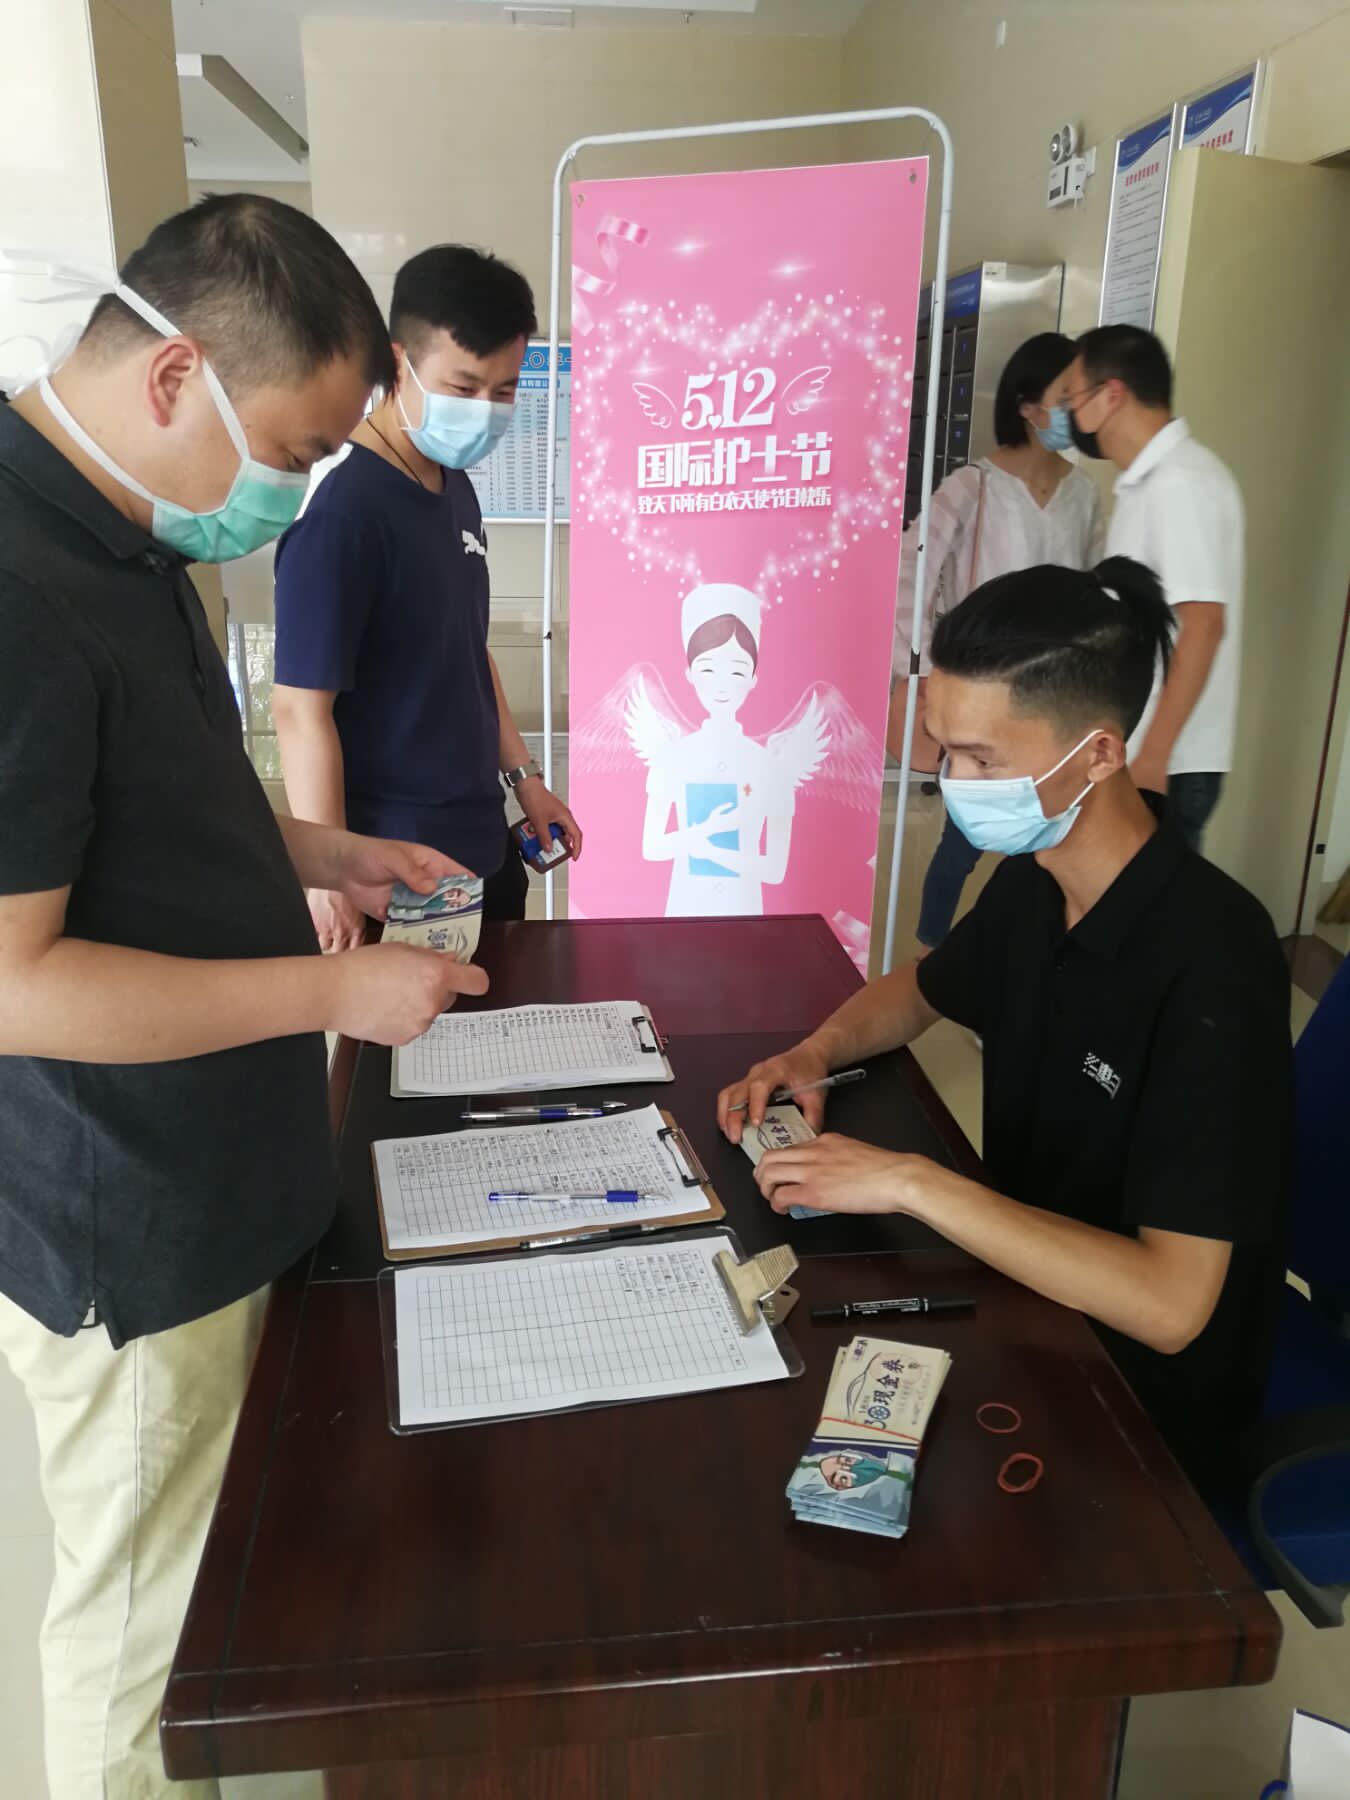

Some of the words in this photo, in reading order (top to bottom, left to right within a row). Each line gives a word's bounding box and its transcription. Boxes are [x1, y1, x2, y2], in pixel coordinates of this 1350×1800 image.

[637, 431, 833, 489] 国际护士节
[637, 486, 832, 515] 致天下所有白衣天使节日快乐
